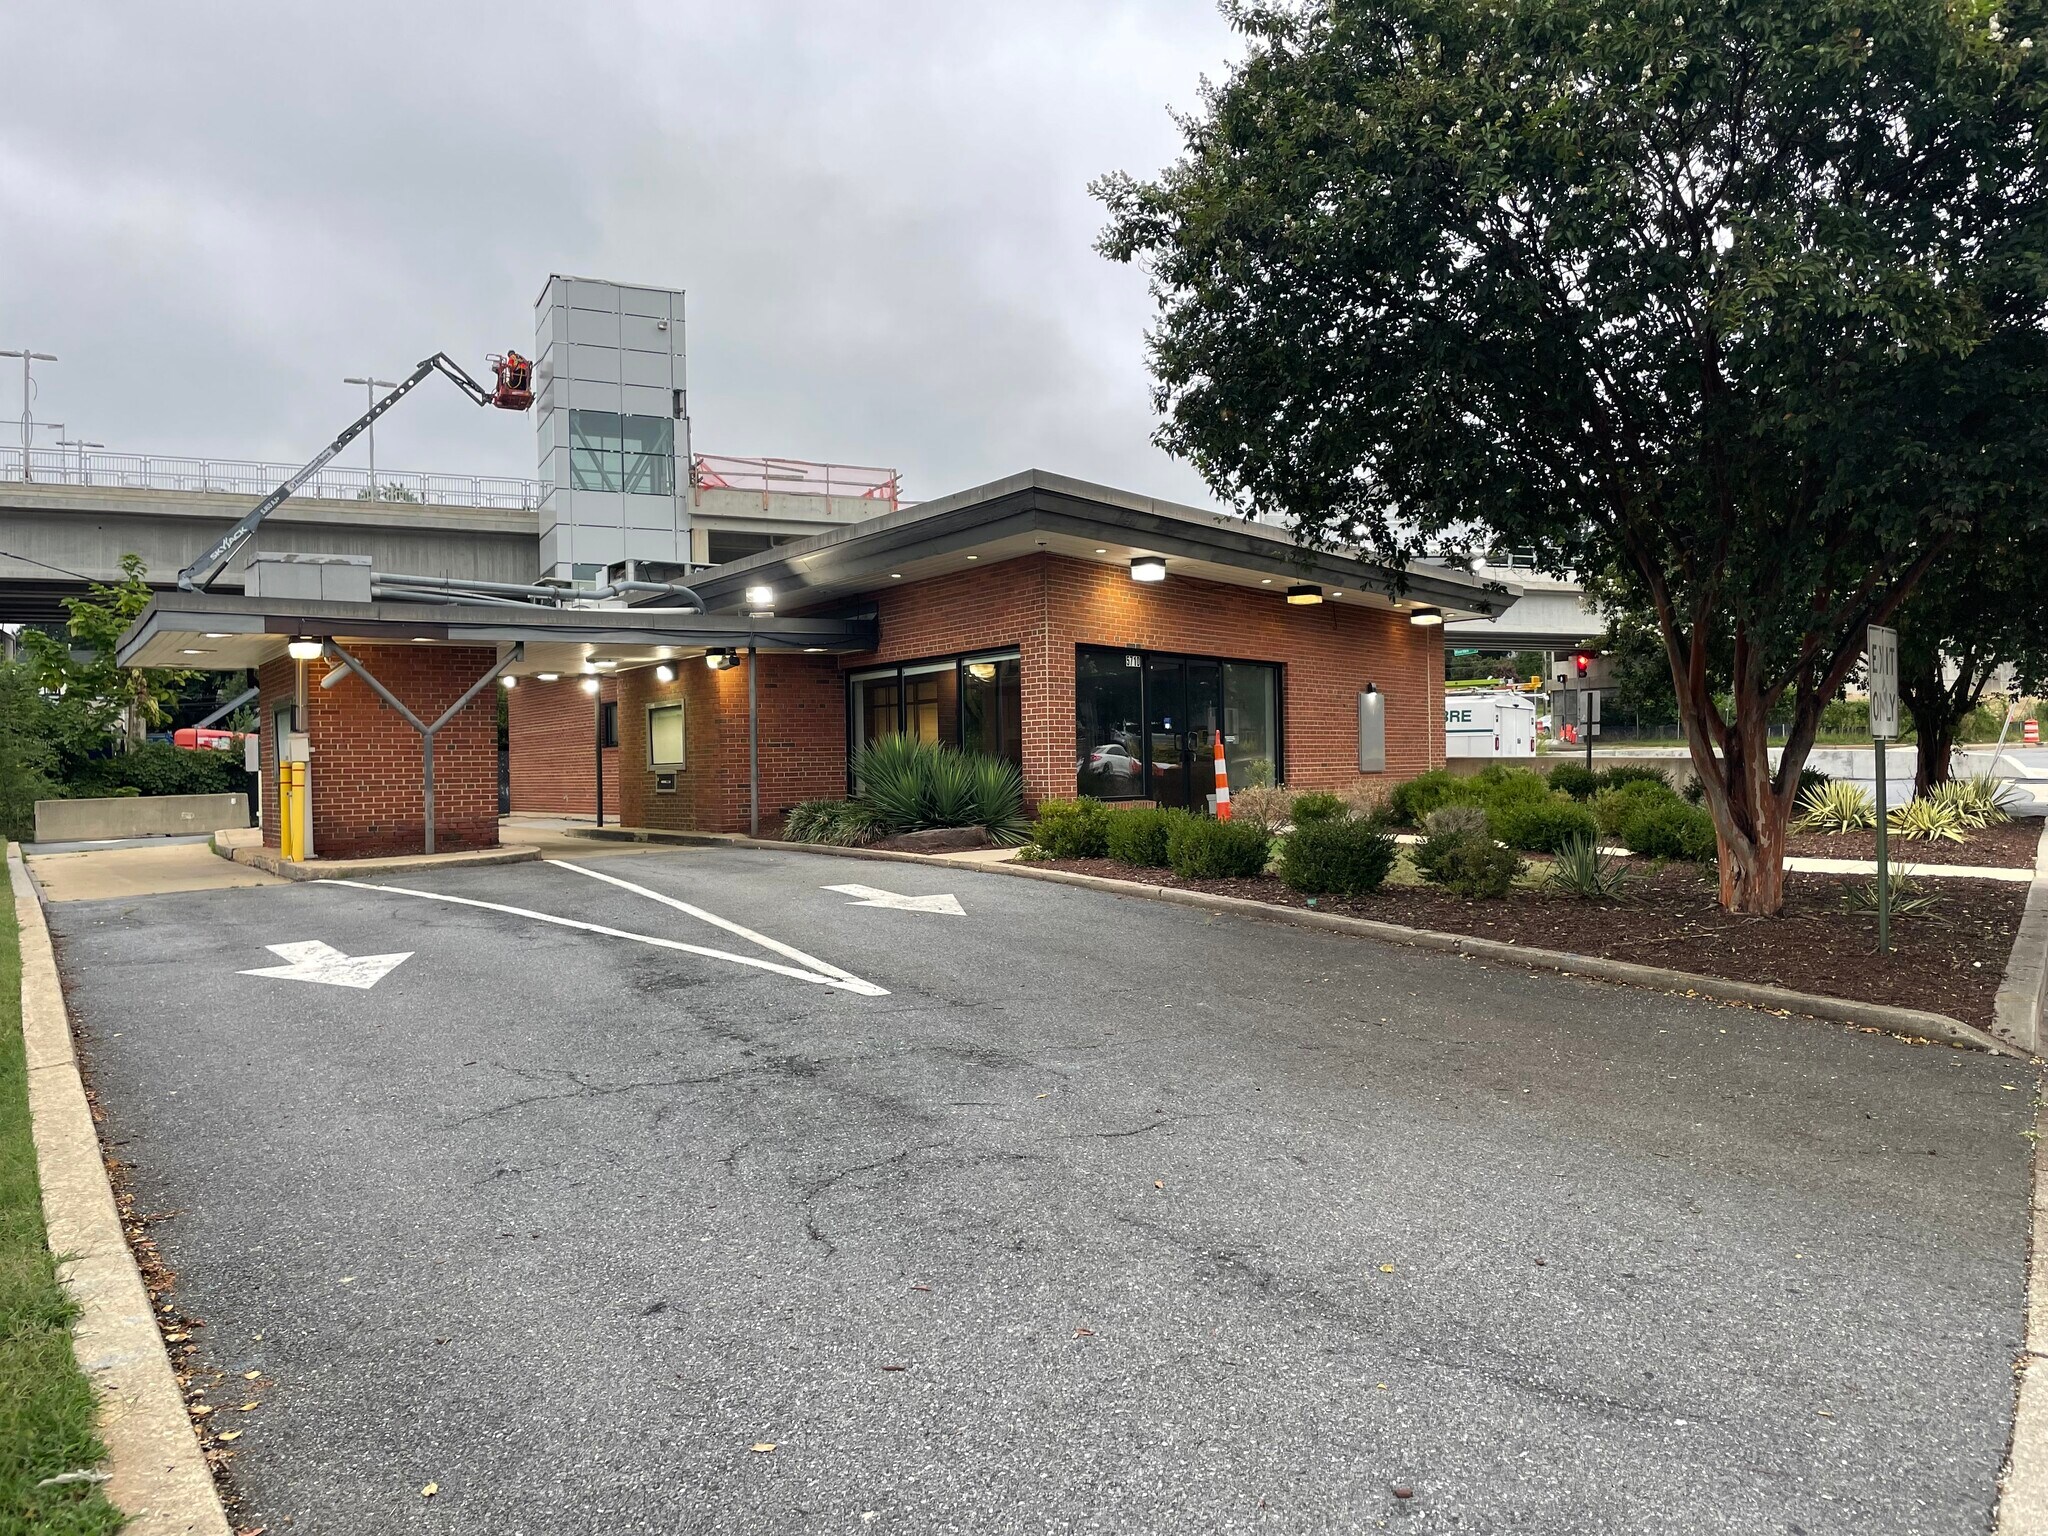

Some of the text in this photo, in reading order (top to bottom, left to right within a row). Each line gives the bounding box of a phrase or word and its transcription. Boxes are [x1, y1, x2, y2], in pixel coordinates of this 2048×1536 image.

[209, 526, 248, 561] SKYJACK
[1125, 655, 1141, 667] 5710
[1872, 644, 1895, 676] EXIT
[1873, 691, 1896, 722] ONLY
